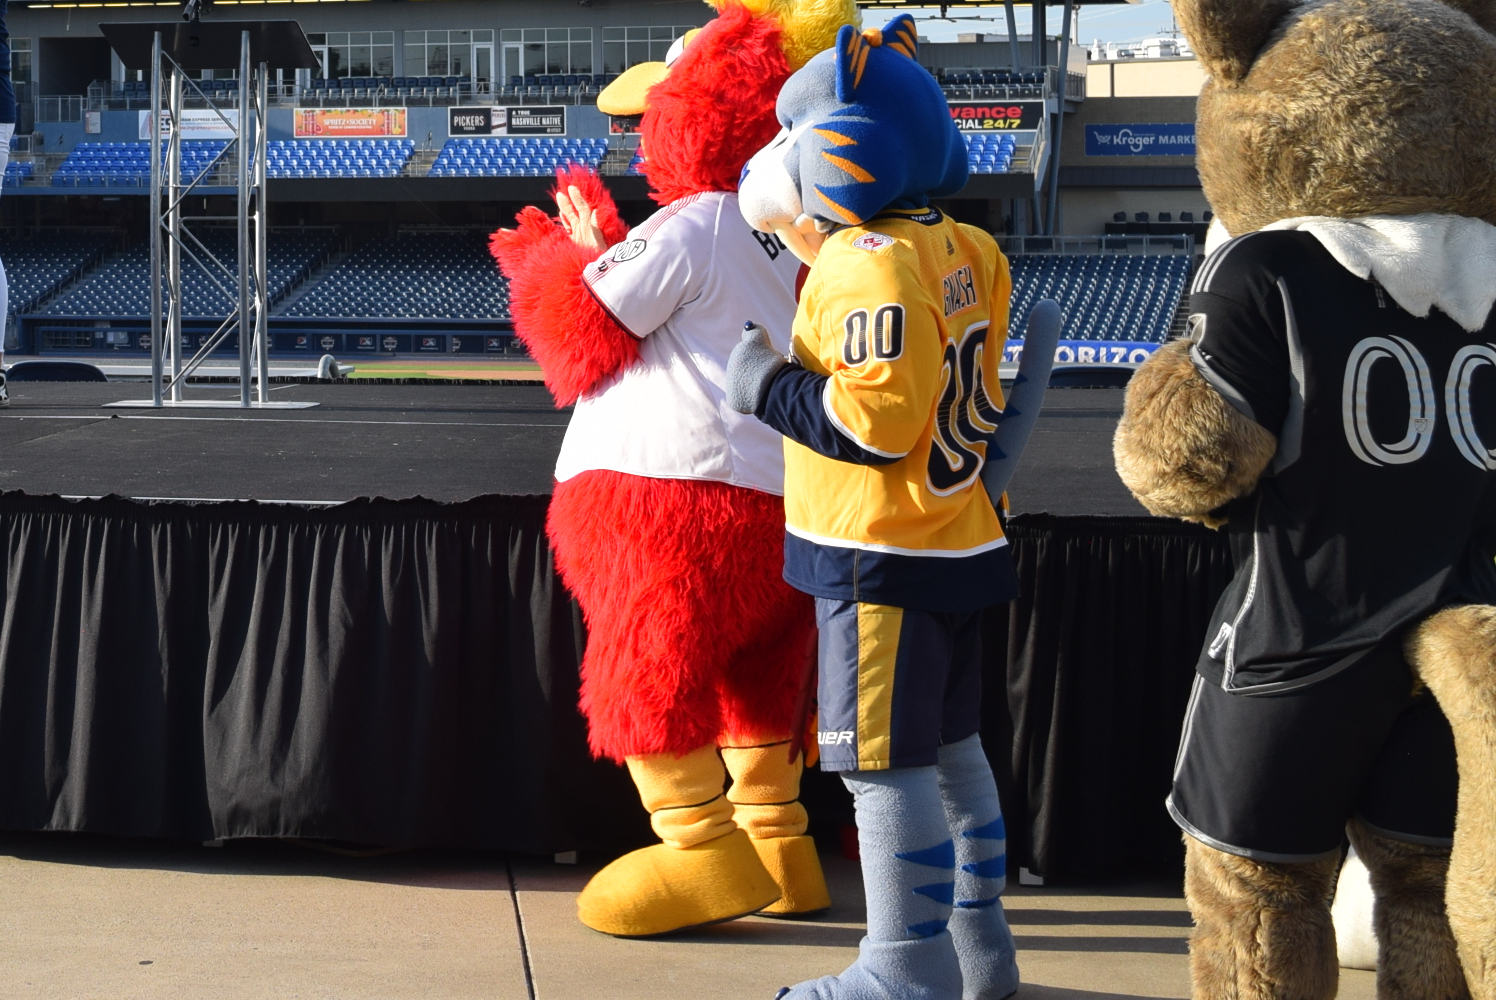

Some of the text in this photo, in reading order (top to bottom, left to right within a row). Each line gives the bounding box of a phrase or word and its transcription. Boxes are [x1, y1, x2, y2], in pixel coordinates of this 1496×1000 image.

[453, 115, 484, 127] PICKERS
[511, 116, 561, 126] NASHVILLE NATIVE
[1113, 128, 1156, 153] Kroger
[942, 265, 978, 318] GNASH
[842, 302, 906, 368] 00
